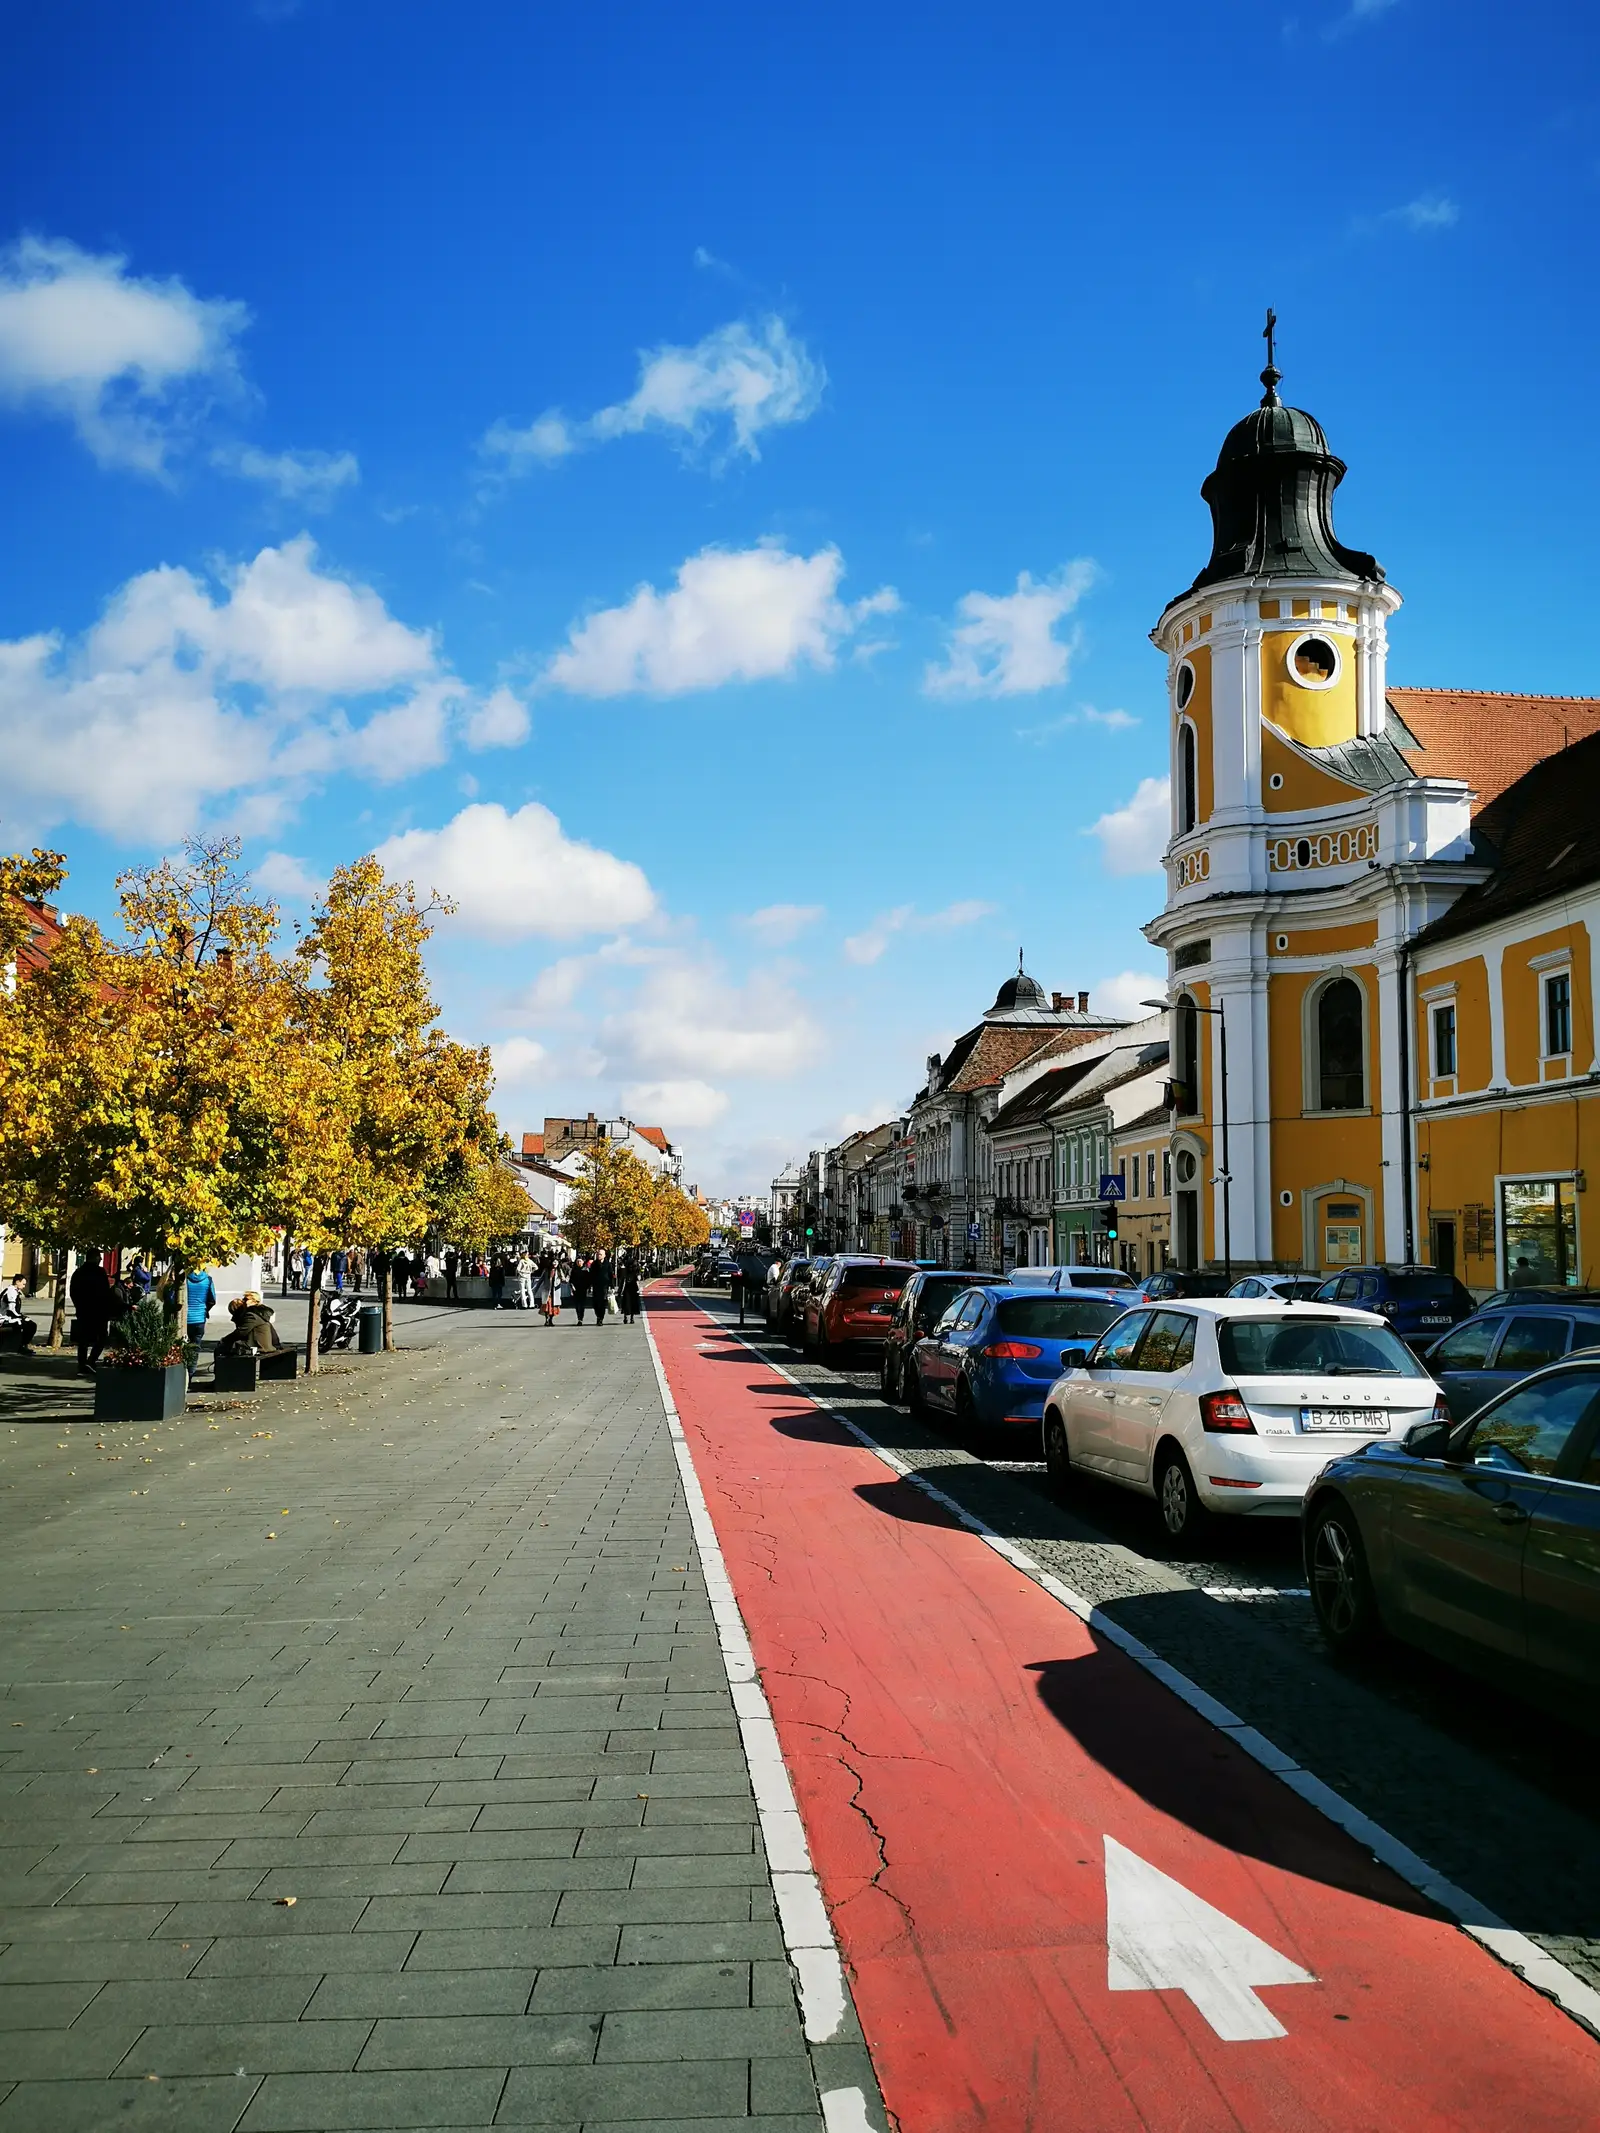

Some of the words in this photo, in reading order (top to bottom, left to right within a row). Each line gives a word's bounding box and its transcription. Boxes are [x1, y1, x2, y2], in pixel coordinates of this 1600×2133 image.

[1312, 1410, 1323, 1425] B
[1328, 1410, 1350, 1425] 216
[1353, 1410, 1384, 1426] PMR
